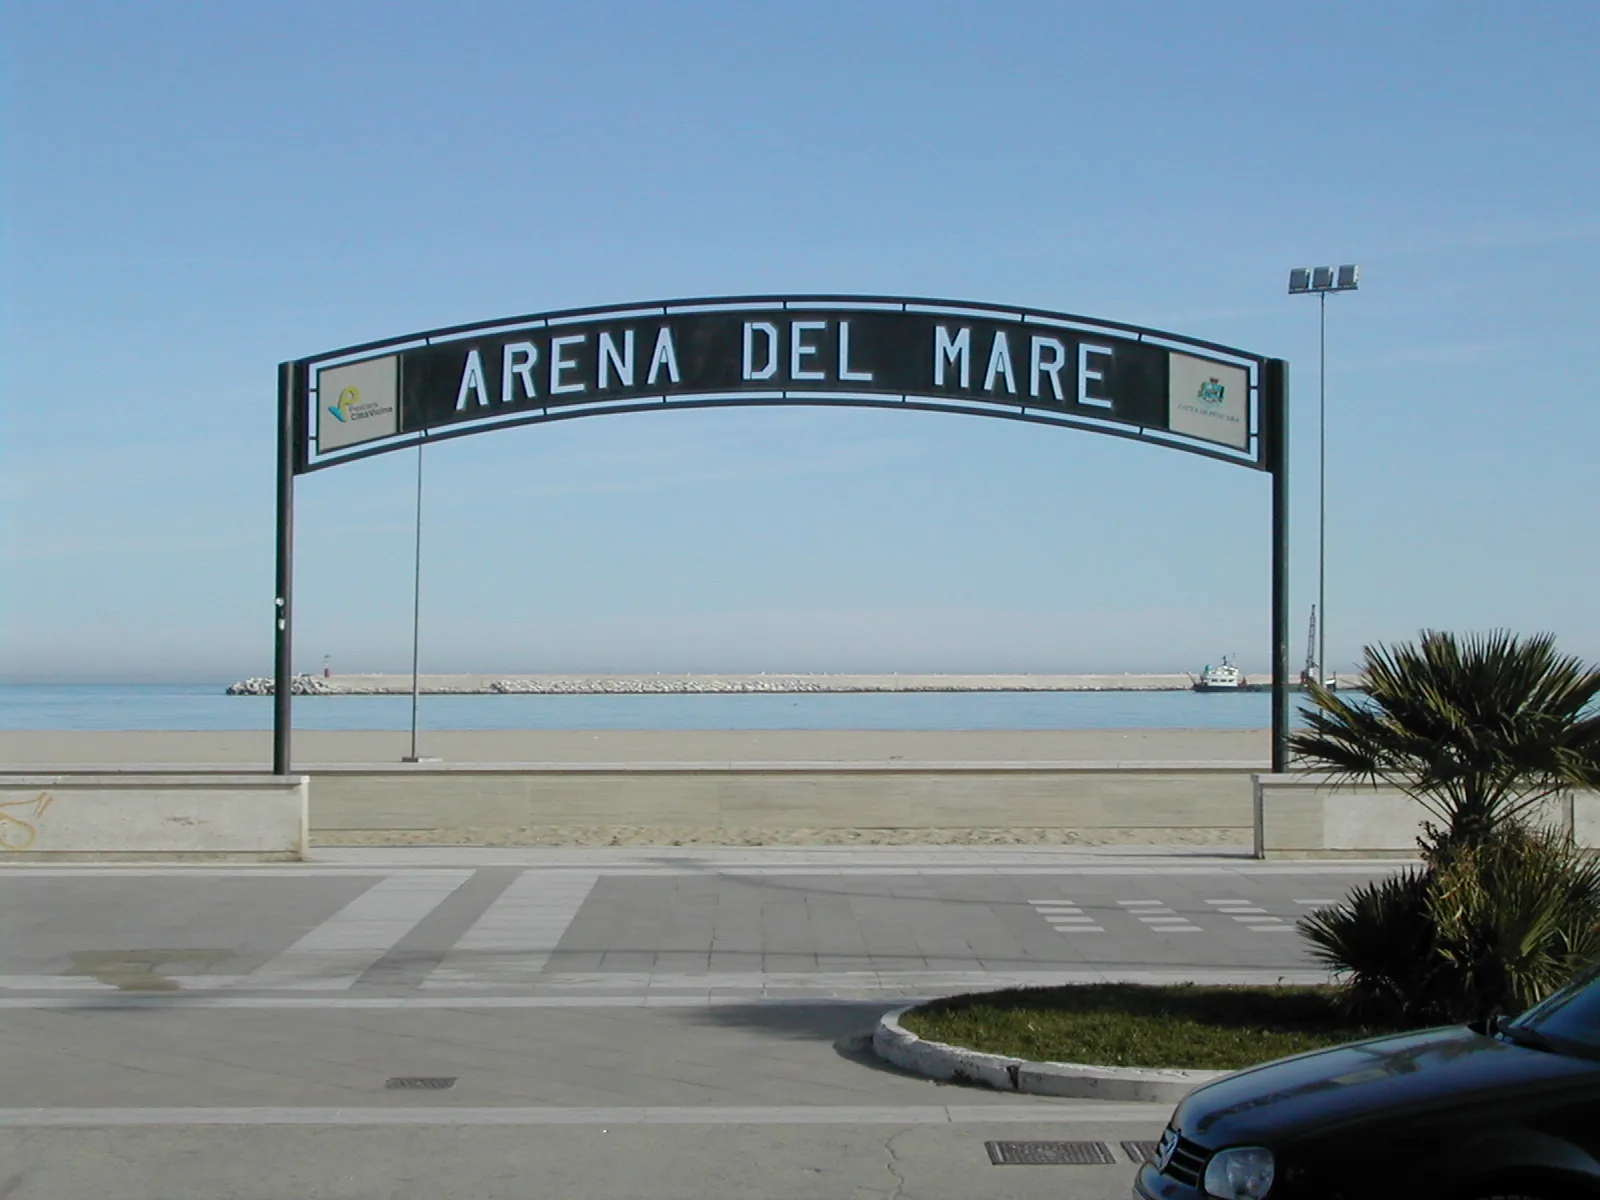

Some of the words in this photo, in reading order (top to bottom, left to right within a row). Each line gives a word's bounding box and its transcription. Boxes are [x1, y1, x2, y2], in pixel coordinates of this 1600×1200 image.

[455, 327, 680, 411] ARENA
[742, 321, 873, 381] DEL
[934, 325, 1113, 409] MARE
